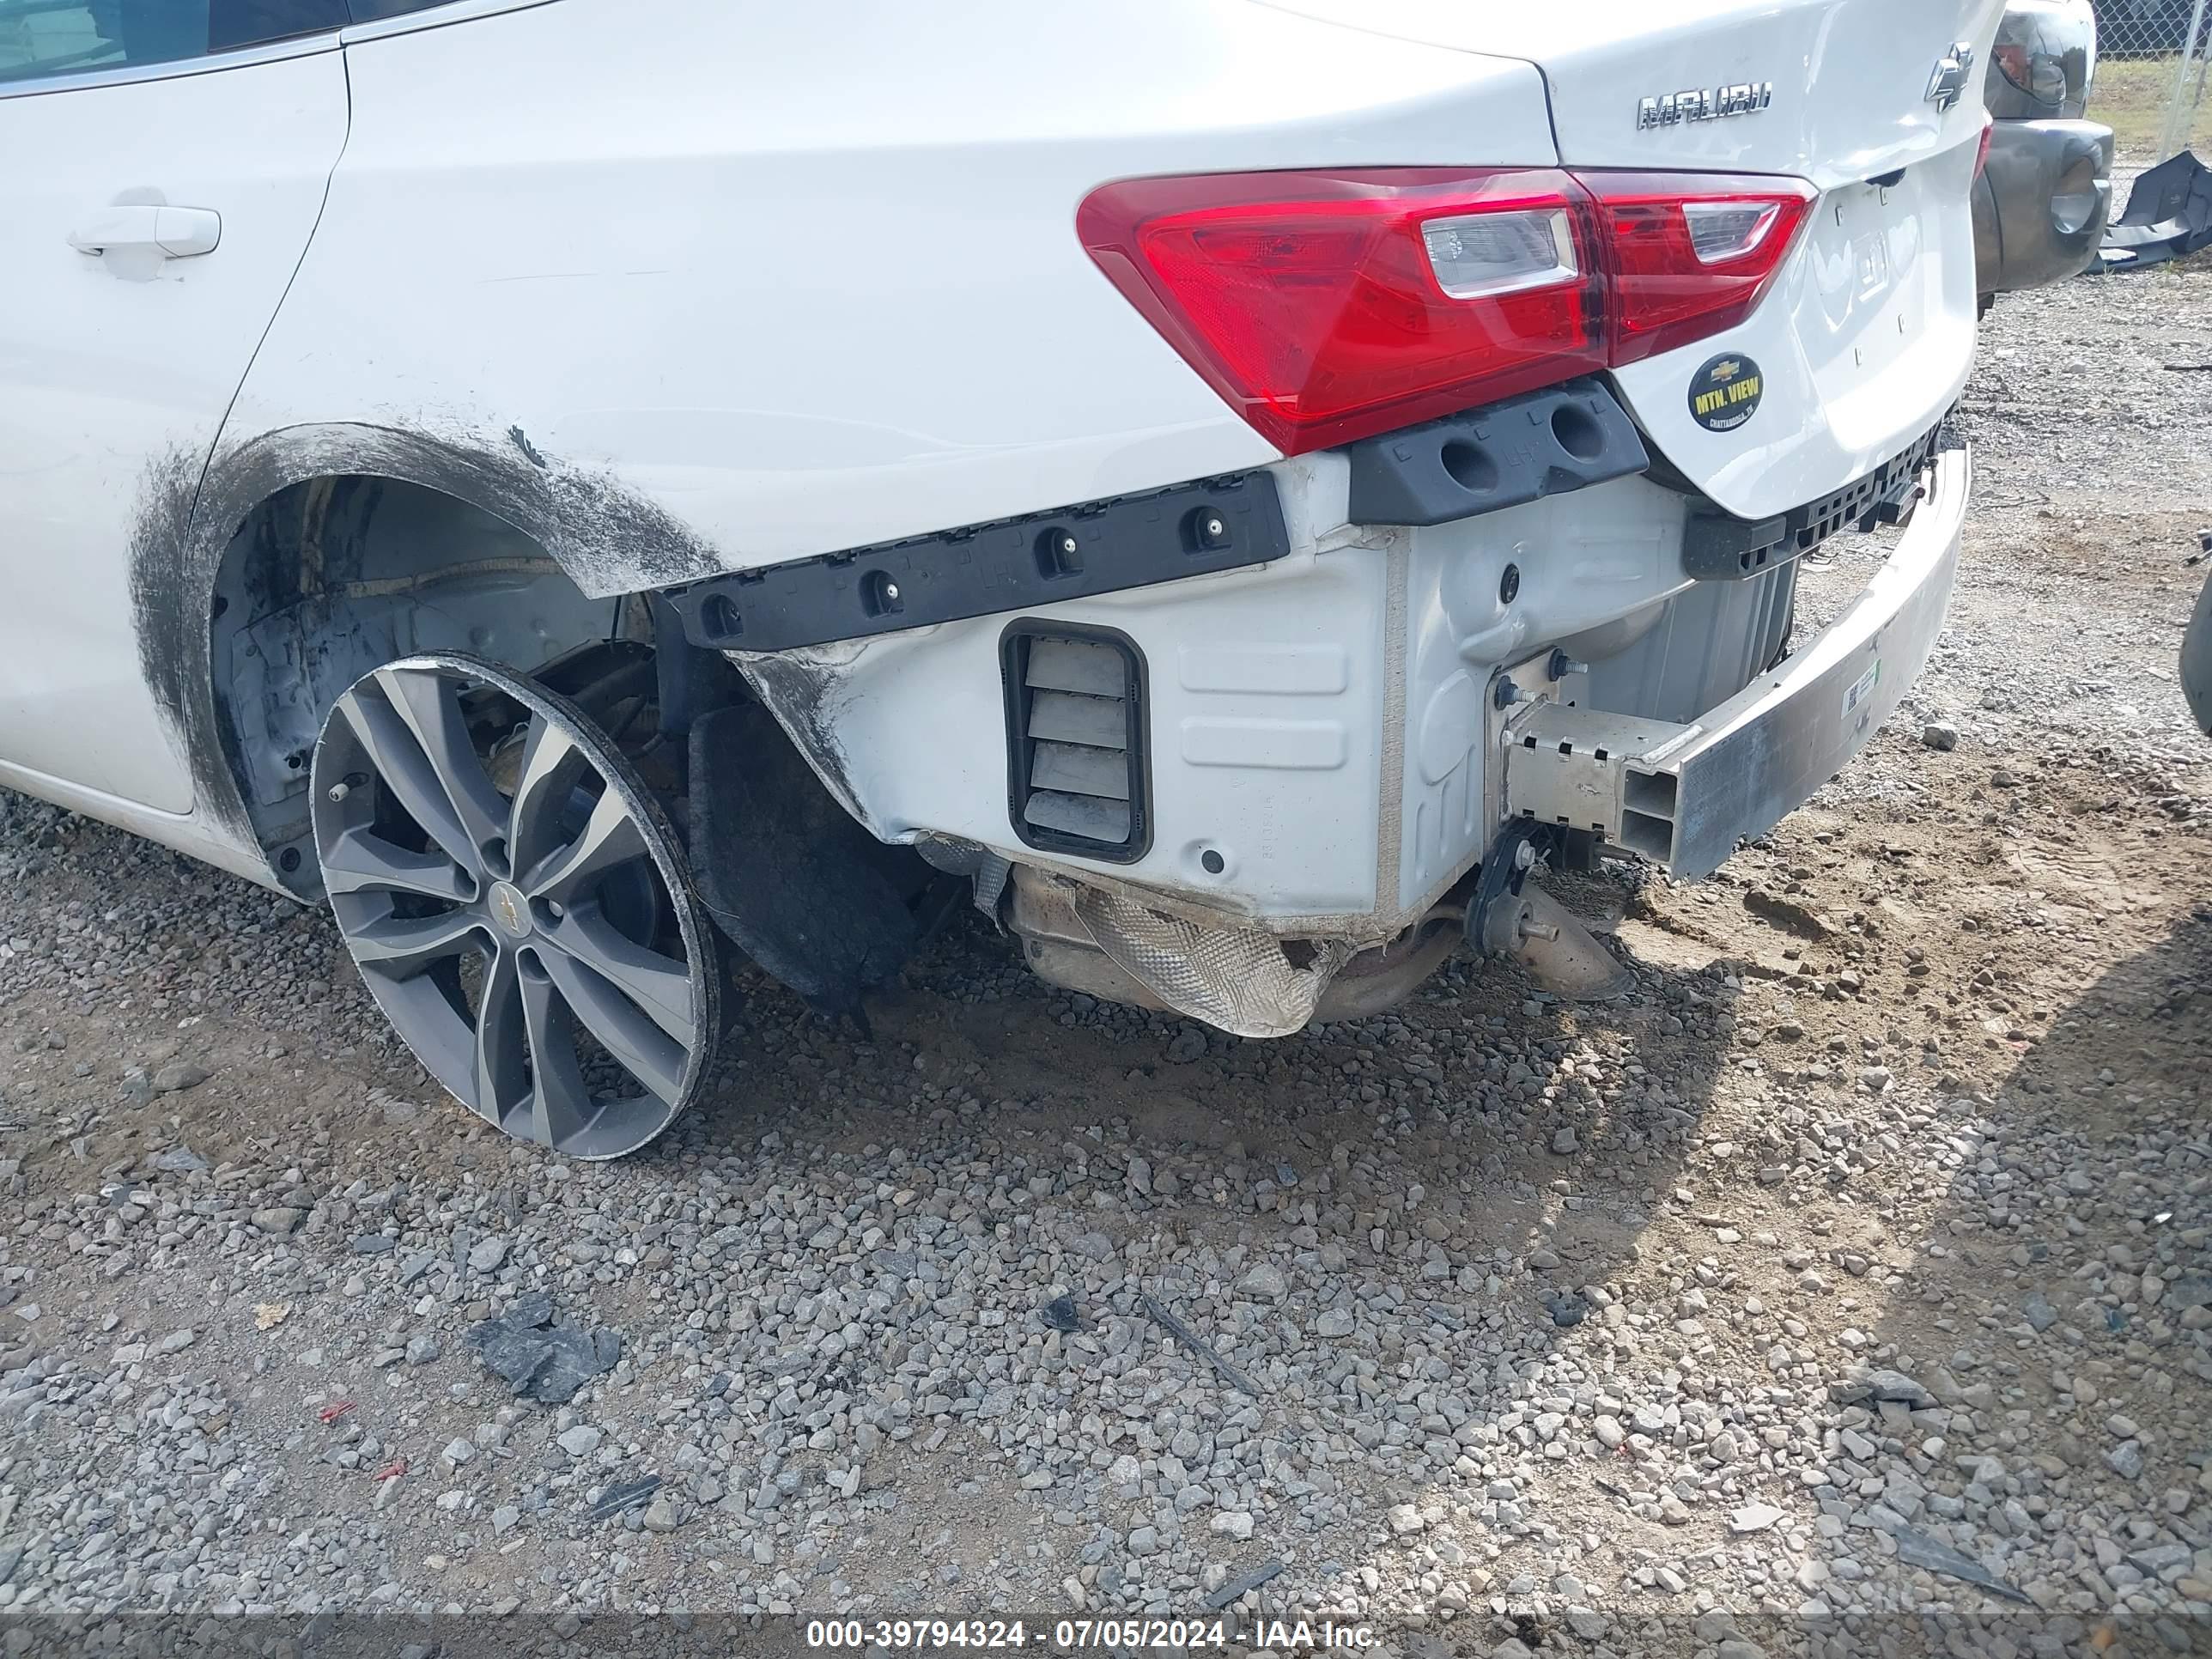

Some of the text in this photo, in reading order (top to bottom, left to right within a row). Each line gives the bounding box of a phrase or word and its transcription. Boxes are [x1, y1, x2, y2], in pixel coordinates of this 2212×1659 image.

[1637, 82, 1772, 131] MALIBU
[1695, 376, 1759, 416] MTN. VIEW
